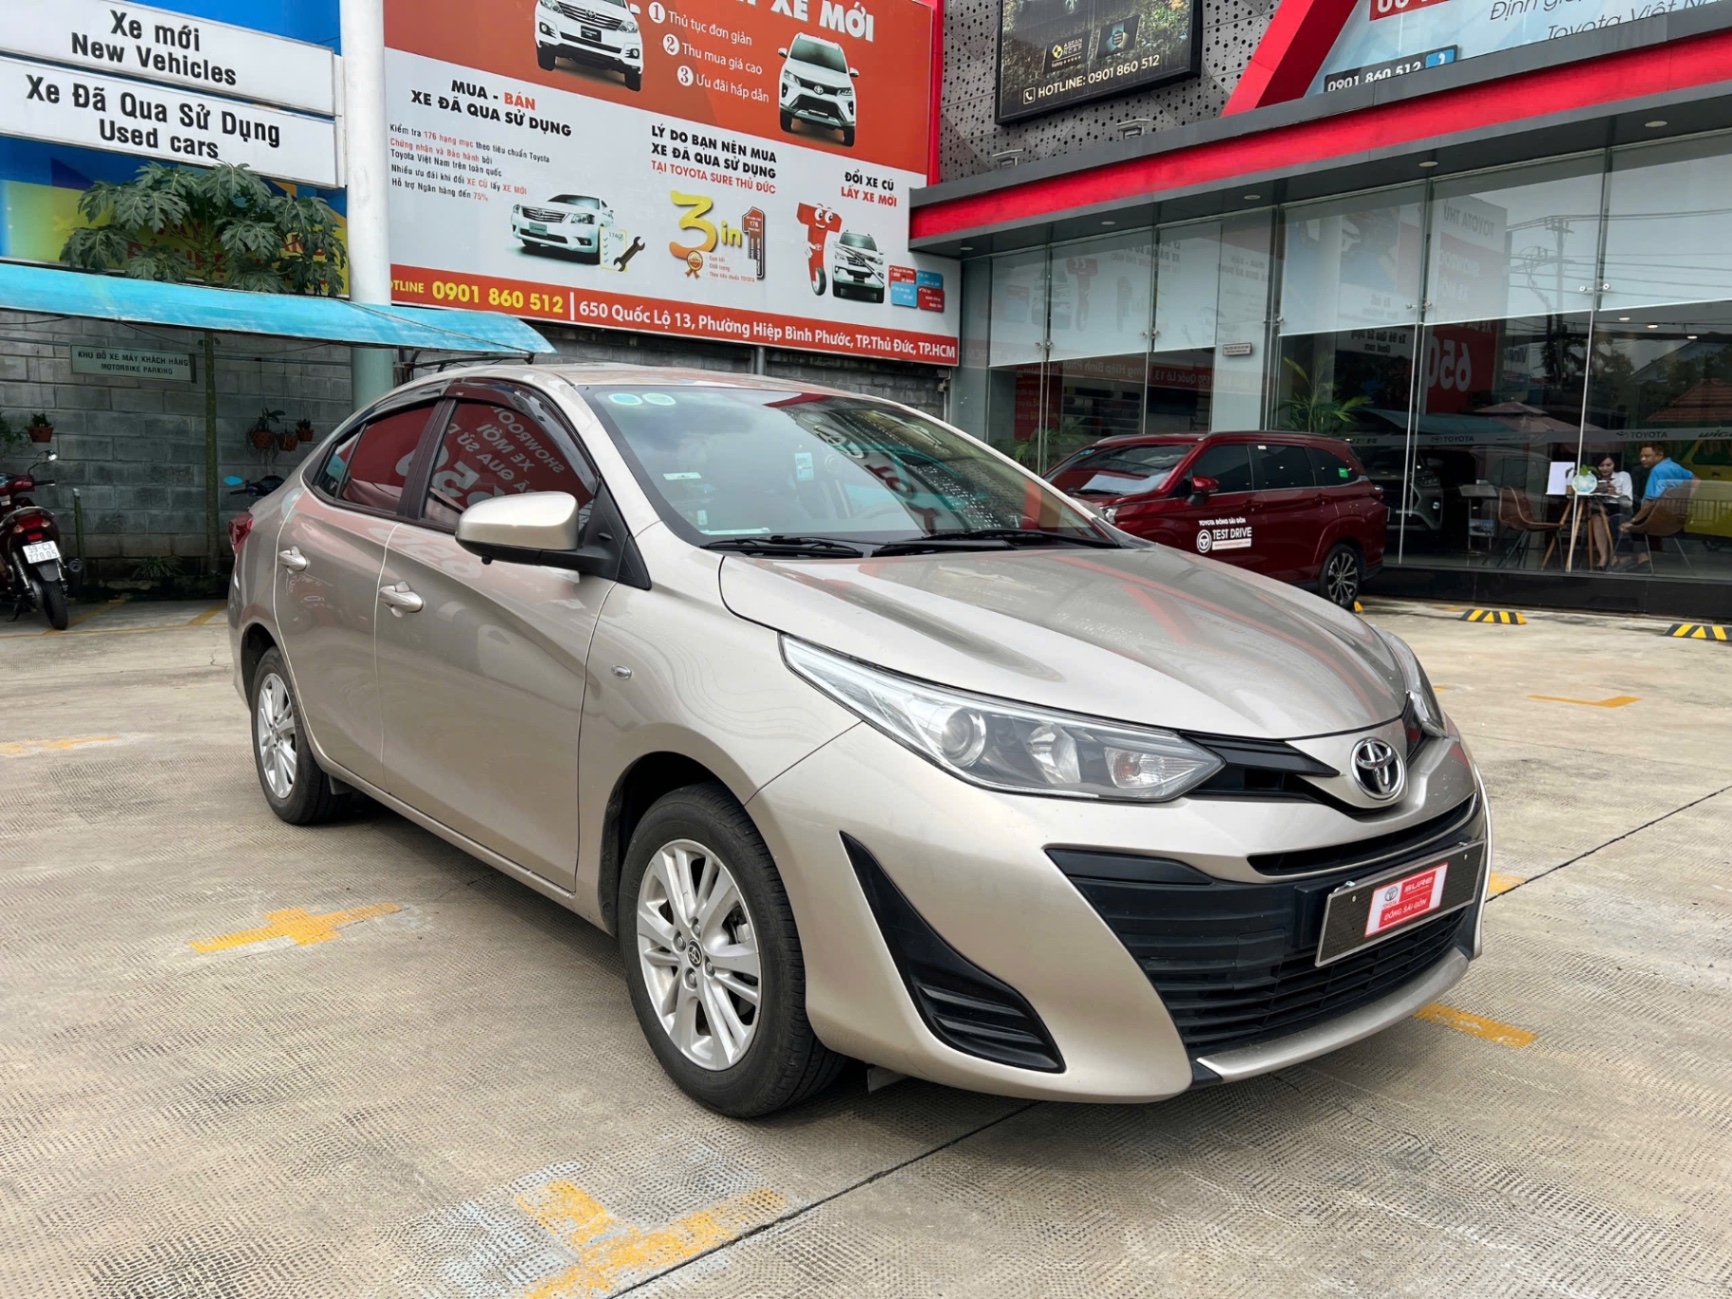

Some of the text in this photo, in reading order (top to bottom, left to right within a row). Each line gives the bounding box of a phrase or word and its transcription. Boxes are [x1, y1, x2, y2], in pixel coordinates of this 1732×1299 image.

[770, 0, 874, 43] XE MỚI
[1490, 0, 1536, 21] Định
[110, 9, 200, 51] Xe mới
[668, 10, 688, 28] Thủ
[691, 19, 707, 34] tục
[709, 22, 728, 40] đơn
[731, 29, 752, 47] giản
[71, 32, 236, 85] New Vehicles
[682, 42, 702, 58] Thu
[704, 50, 727, 65] mua
[729, 54, 743, 71] giá
[745, 62, 763, 75] cao
[696, 73, 711, 88] Ưu
[713, 77, 729, 93] đãi
[730, 82, 749, 100] hấp
[751, 87, 769, 103] dẫn
[1038, 54, 1160, 98] HOTLINE: 0901 860 512
[1328, 76, 1359, 92] 0901
[1365, 69, 1391, 83] 860
[26, 75, 280, 148] Xe Đã Qua Sử Dụng
[451, 79, 536, 111] MUA BÁN
[411, 89, 572, 137] XE ĐÃ QUA SỬ DỤNG
[99, 118, 219, 159] Used cars
[411, 128, 422, 137] tra
[424, 130, 437, 141] 176
[476, 141, 490, 152] theo
[529, 151, 550, 164] Toyota
[652, 123, 777, 163] LÝ DO BẠN NÊN MUA
[390, 149, 415, 161] Toyota
[417, 153, 432, 165] Việt
[434, 157, 450, 168] Nam
[652, 143, 776, 180] XE ĐÃ QUA SỬ DỤNG
[466, 177, 476, 186] XE
[502, 184, 512, 193] XE
[651, 160, 776, 195] TẠI TOYOTA SURE THỦ ĐỨC
[844, 168, 894, 191] ĐỔI XE CŨ
[473, 191, 489, 202] 75%
[841, 186, 897, 207] LẤY XE MỚI
[391, 279, 956, 359] TLINE 0901 860 512 650 Quốc Lộ 13, Phường Hiệp Bình Phước, TP.Thủ Đức, TP.HCM
[78, 351, 93, 359] KHU
[141, 355, 166, 365] KHÁCH
[100, 363, 173, 375] MOTORBIKE PARKING
[1631, 430, 1667, 439] TOYOTA
[1212, 527, 1252, 540] TEST DRIVE
